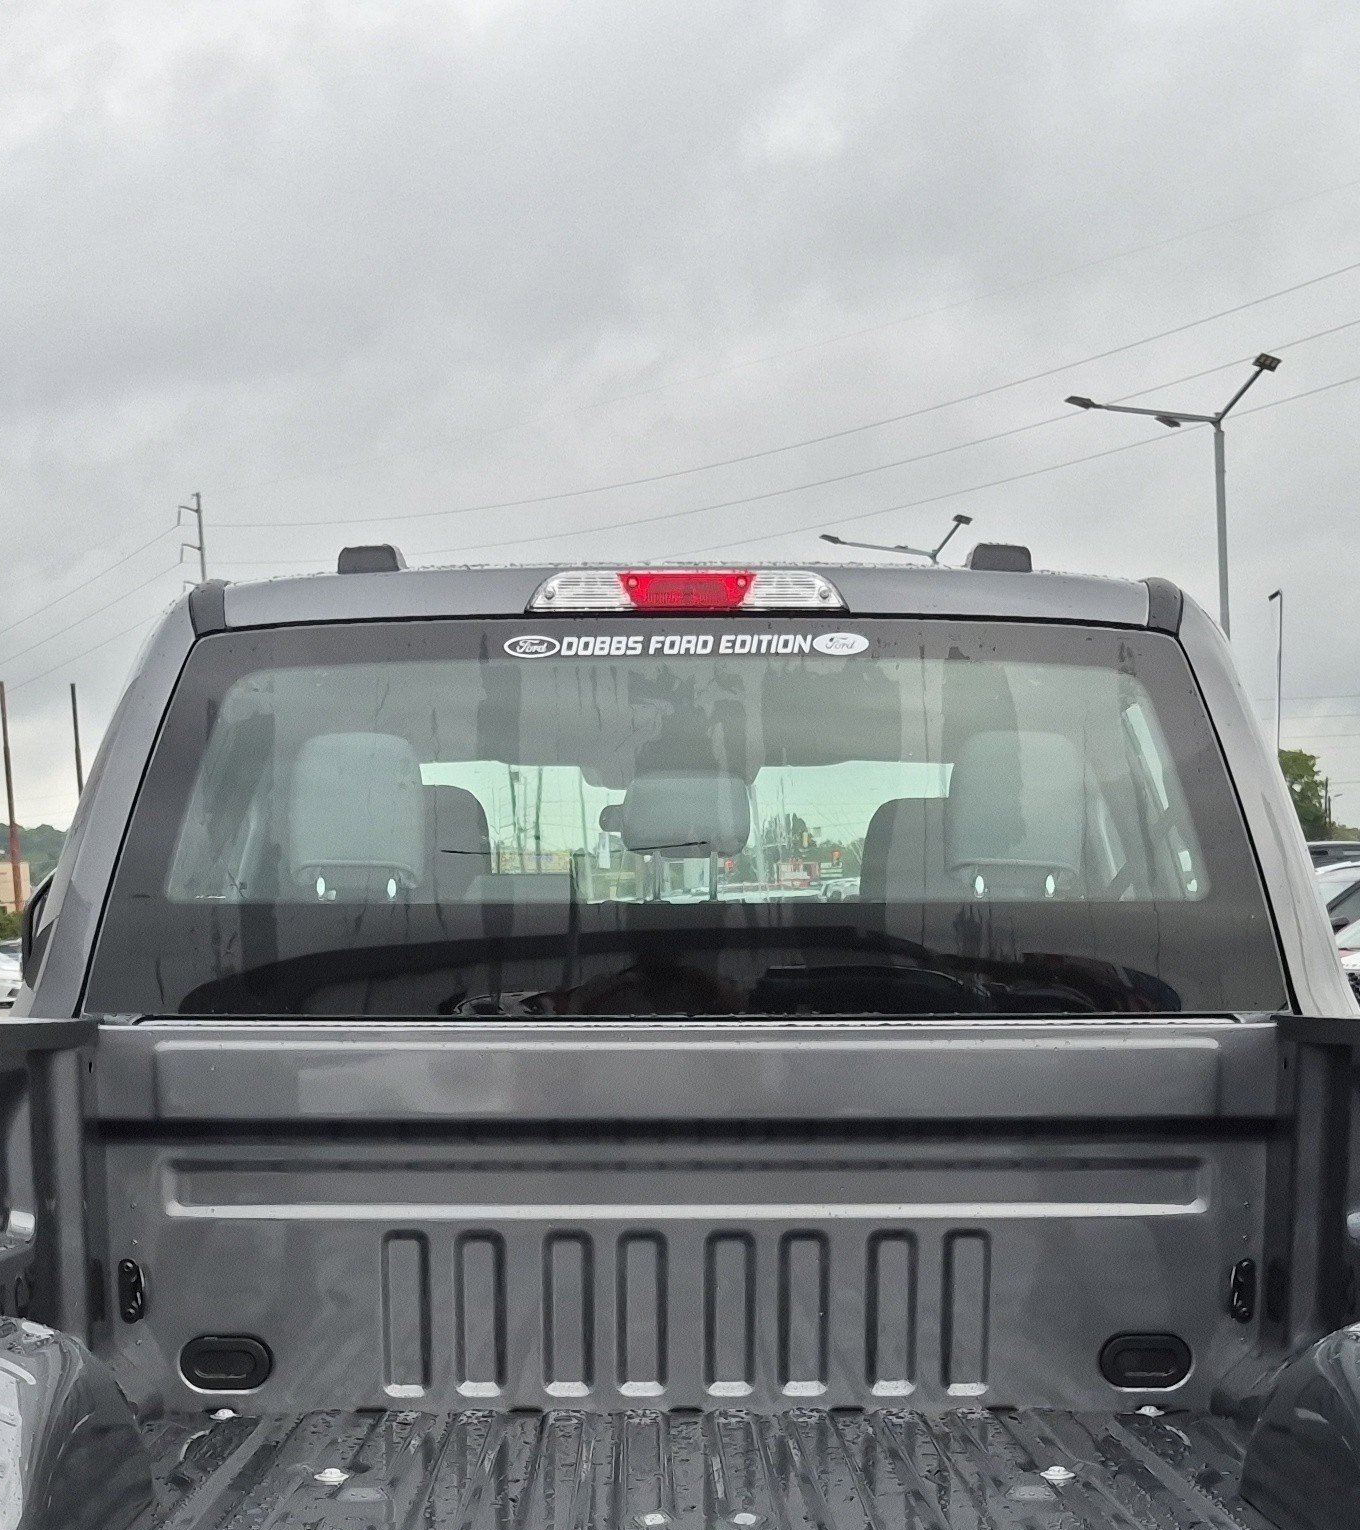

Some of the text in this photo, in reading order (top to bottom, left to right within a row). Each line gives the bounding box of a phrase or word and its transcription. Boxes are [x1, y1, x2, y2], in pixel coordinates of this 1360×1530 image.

[561, 636, 644, 656] DOBBS
[648, 635, 714, 655] FORD
[719, 634, 813, 654] EDITION
